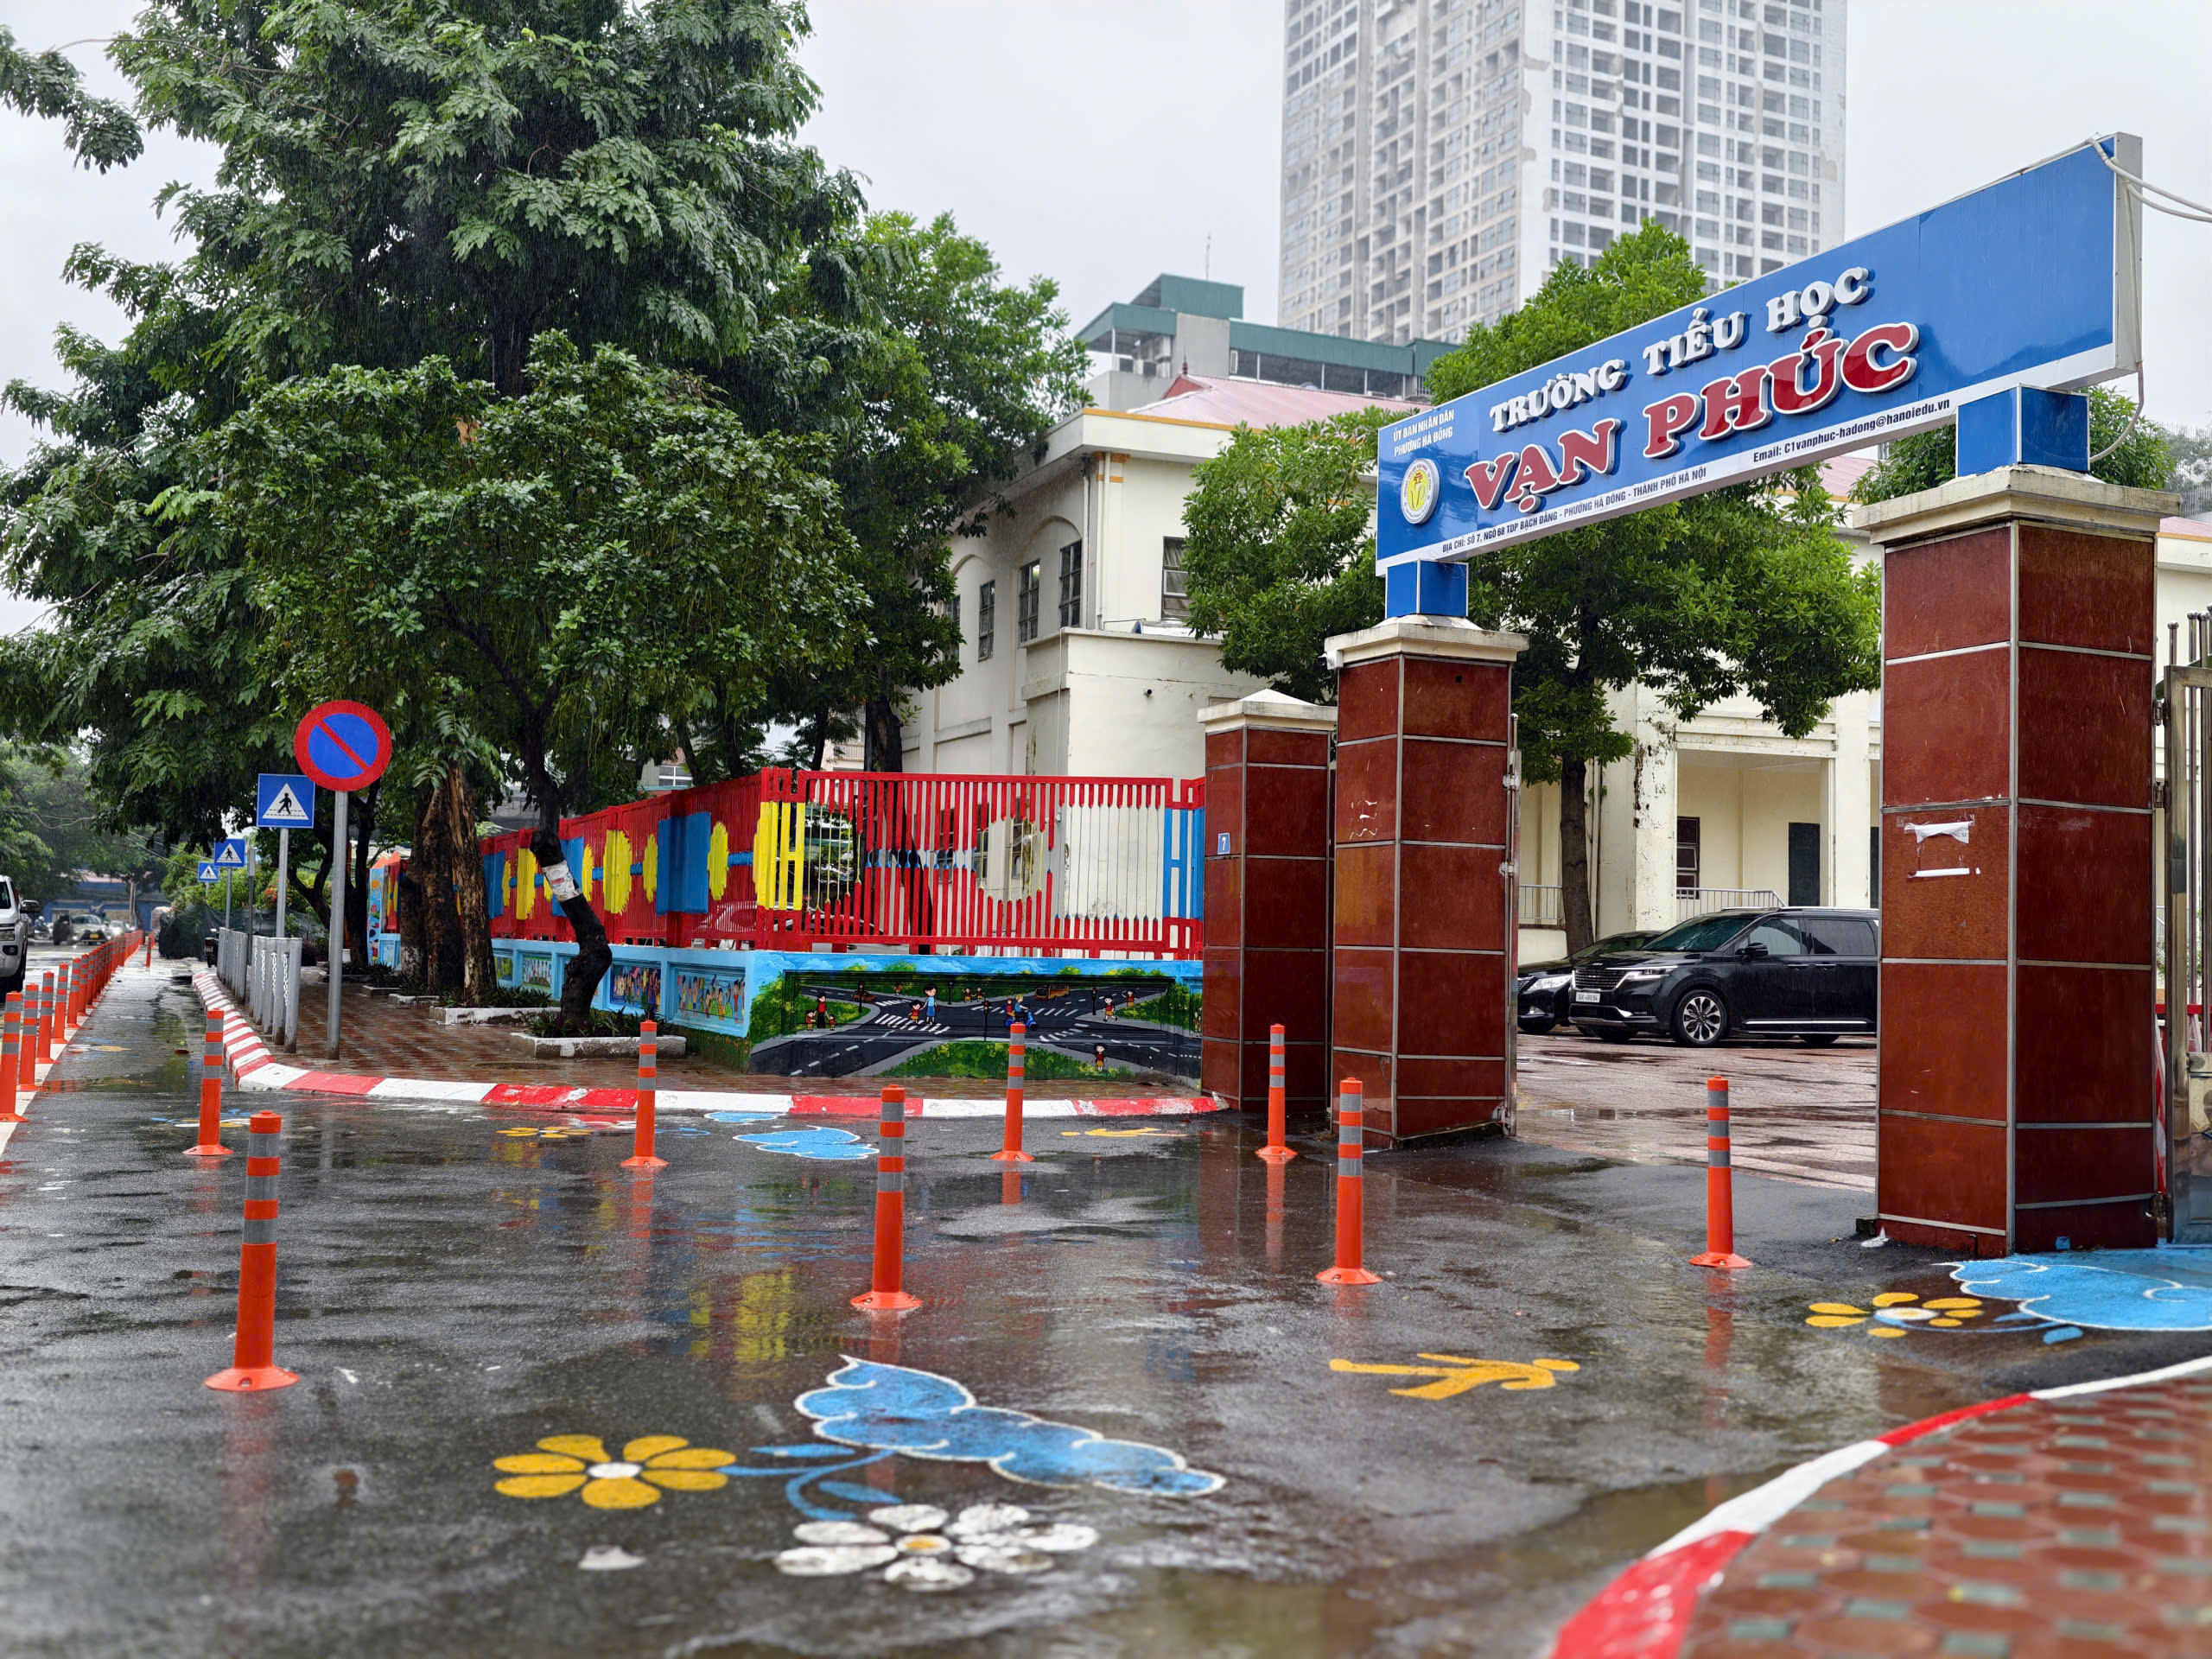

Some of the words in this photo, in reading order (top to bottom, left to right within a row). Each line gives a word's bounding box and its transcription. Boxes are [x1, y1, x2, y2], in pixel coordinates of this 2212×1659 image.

[1489, 359, 1627, 432] TRƯỜNG
[1643, 307, 1746, 375] TIỂU
[1765, 266, 1869, 332] HỌC
[1402, 423, 1417, 438] BAN
[1418, 415, 1438, 433] NHÂN
[1439, 410, 1454, 424] DÂN
[1422, 431, 1432, 448] HÀ
[1464, 417, 1621, 513] VẠN
[1643, 321, 1920, 459] PHÚC
[1753, 446, 1782, 463] Email:
[1784, 398, 1950, 456] C1vanphuc-hadong@hanoiedu.vn
[1497, 527, 1505, 536] 68
[1520, 516, 1538, 531] BẠCH
[1564, 501, 1592, 518] PHƯỜNG
[1594, 497, 1605, 509] HÀ
[1605, 491, 1626, 505] ĐÔNG
[1633, 481, 1659, 498] THÀNH
[1660, 472, 1677, 490] PHỐ
[1679, 469, 1690, 484] HÀ
[1692, 467, 1707, 481] NỘI
[1222, 836, 1226, 851] 7
